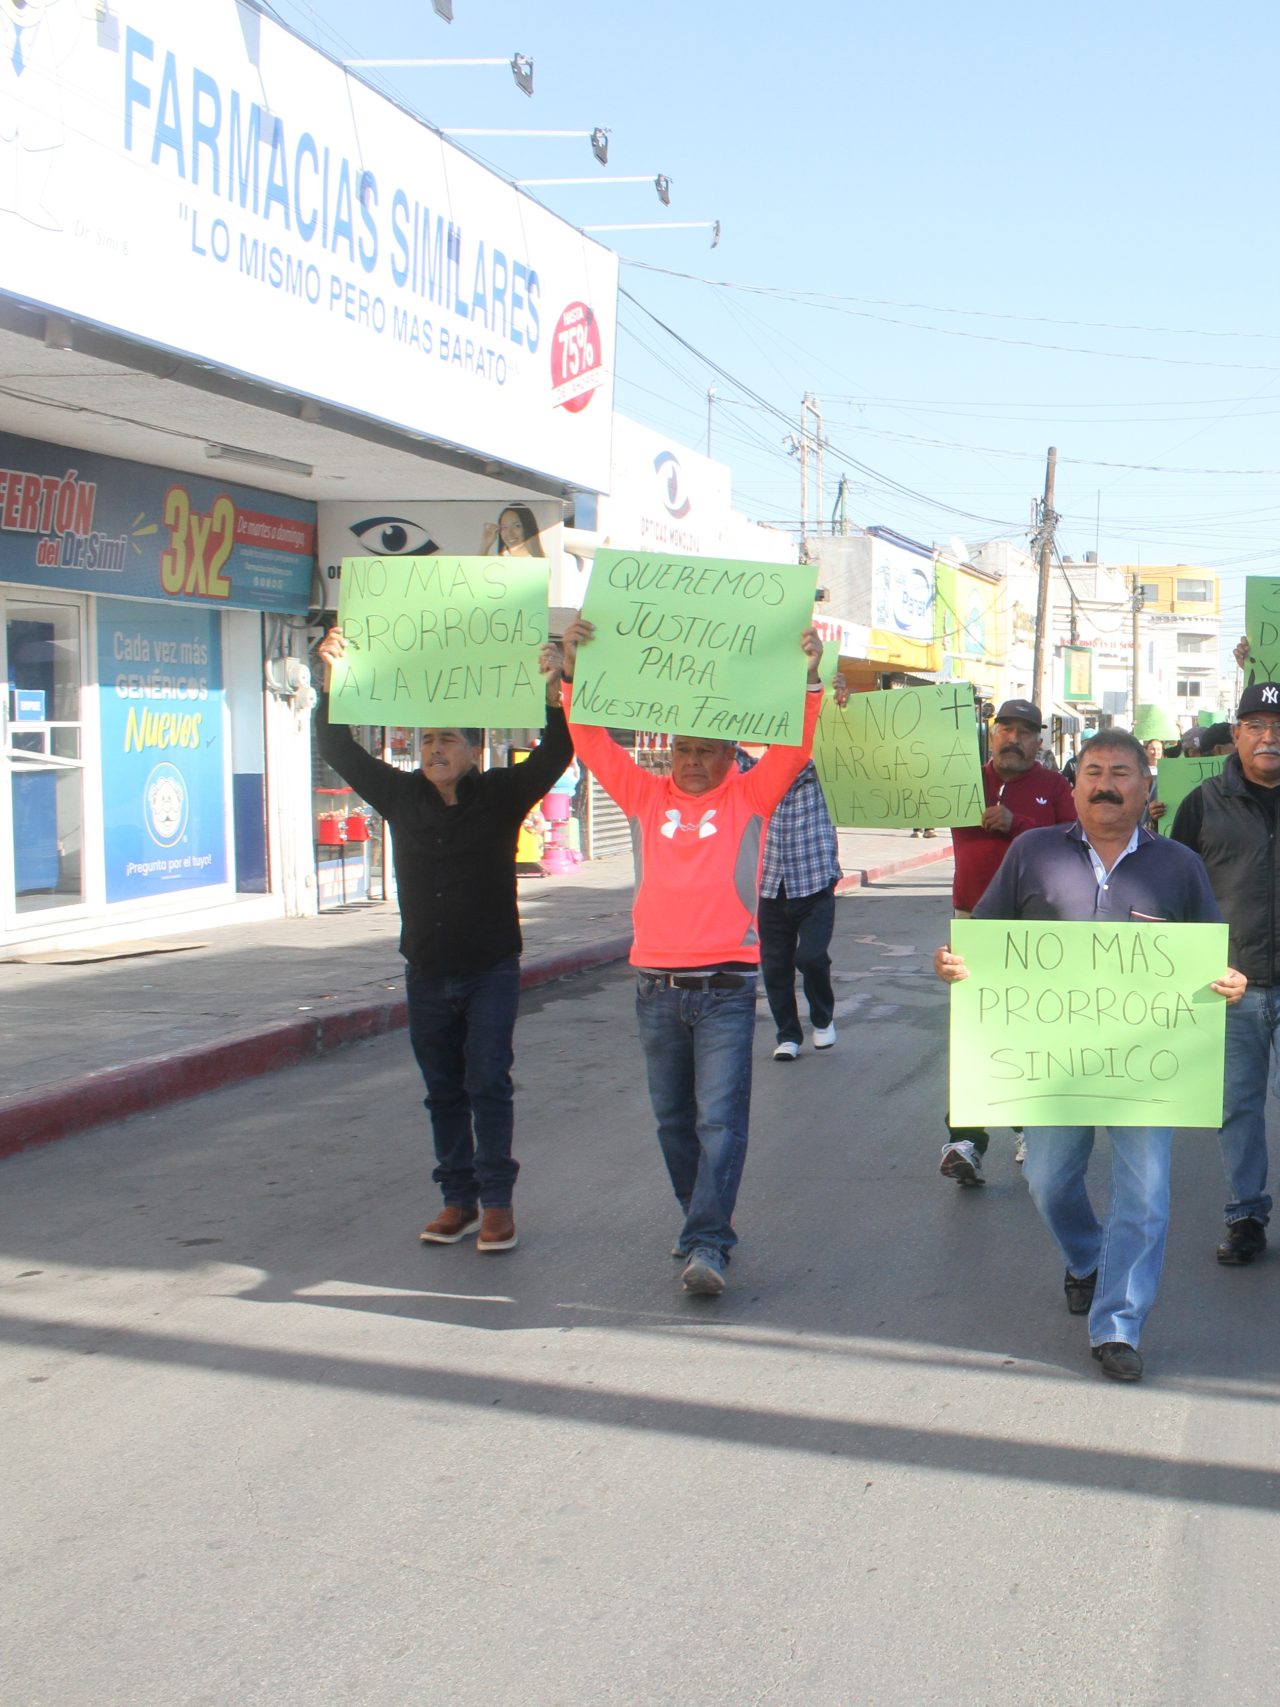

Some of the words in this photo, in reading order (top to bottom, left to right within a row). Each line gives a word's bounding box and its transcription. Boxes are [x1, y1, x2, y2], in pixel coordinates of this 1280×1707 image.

[124, 25, 378, 274] FARMACIAS
[391, 188, 541, 354] SIMILARES
[240, 233, 320, 305] MISMO
[330, 273, 386, 335] PERO
[394, 309, 433, 353] MAS
[558, 323, 594, 379] 75%
[36, 538, 60, 568] del
[348, 560, 388, 600] NO
[404, 559, 507, 600] MAS
[608, 556, 785, 606] QUEREMOS
[113, 631, 150, 663] Cada
[154, 641, 177, 664] vez
[180, 635, 208, 665] más
[616, 601, 756, 656] JUSTICIA
[115, 669, 208, 701] GENÉRICOS
[339, 665, 361, 697] A
[370, 666, 412, 701] LA
[425, 661, 536, 703] VENTA
[638, 646, 717, 691] PARA
[864, 690, 922, 743] NO
[1261, 686, 1280, 704] NY
[124, 707, 203, 753] Nuevos
[818, 740, 930, 783] LARGAS
[940, 736, 973, 776] A
[168, 858, 182, 872] por
[1004, 930, 1064, 971] NO
[1092, 931, 1175, 978] MAS
[978, 985, 1197, 1030] PRORROGA
[989, 1044, 1179, 1082] SINDICO
